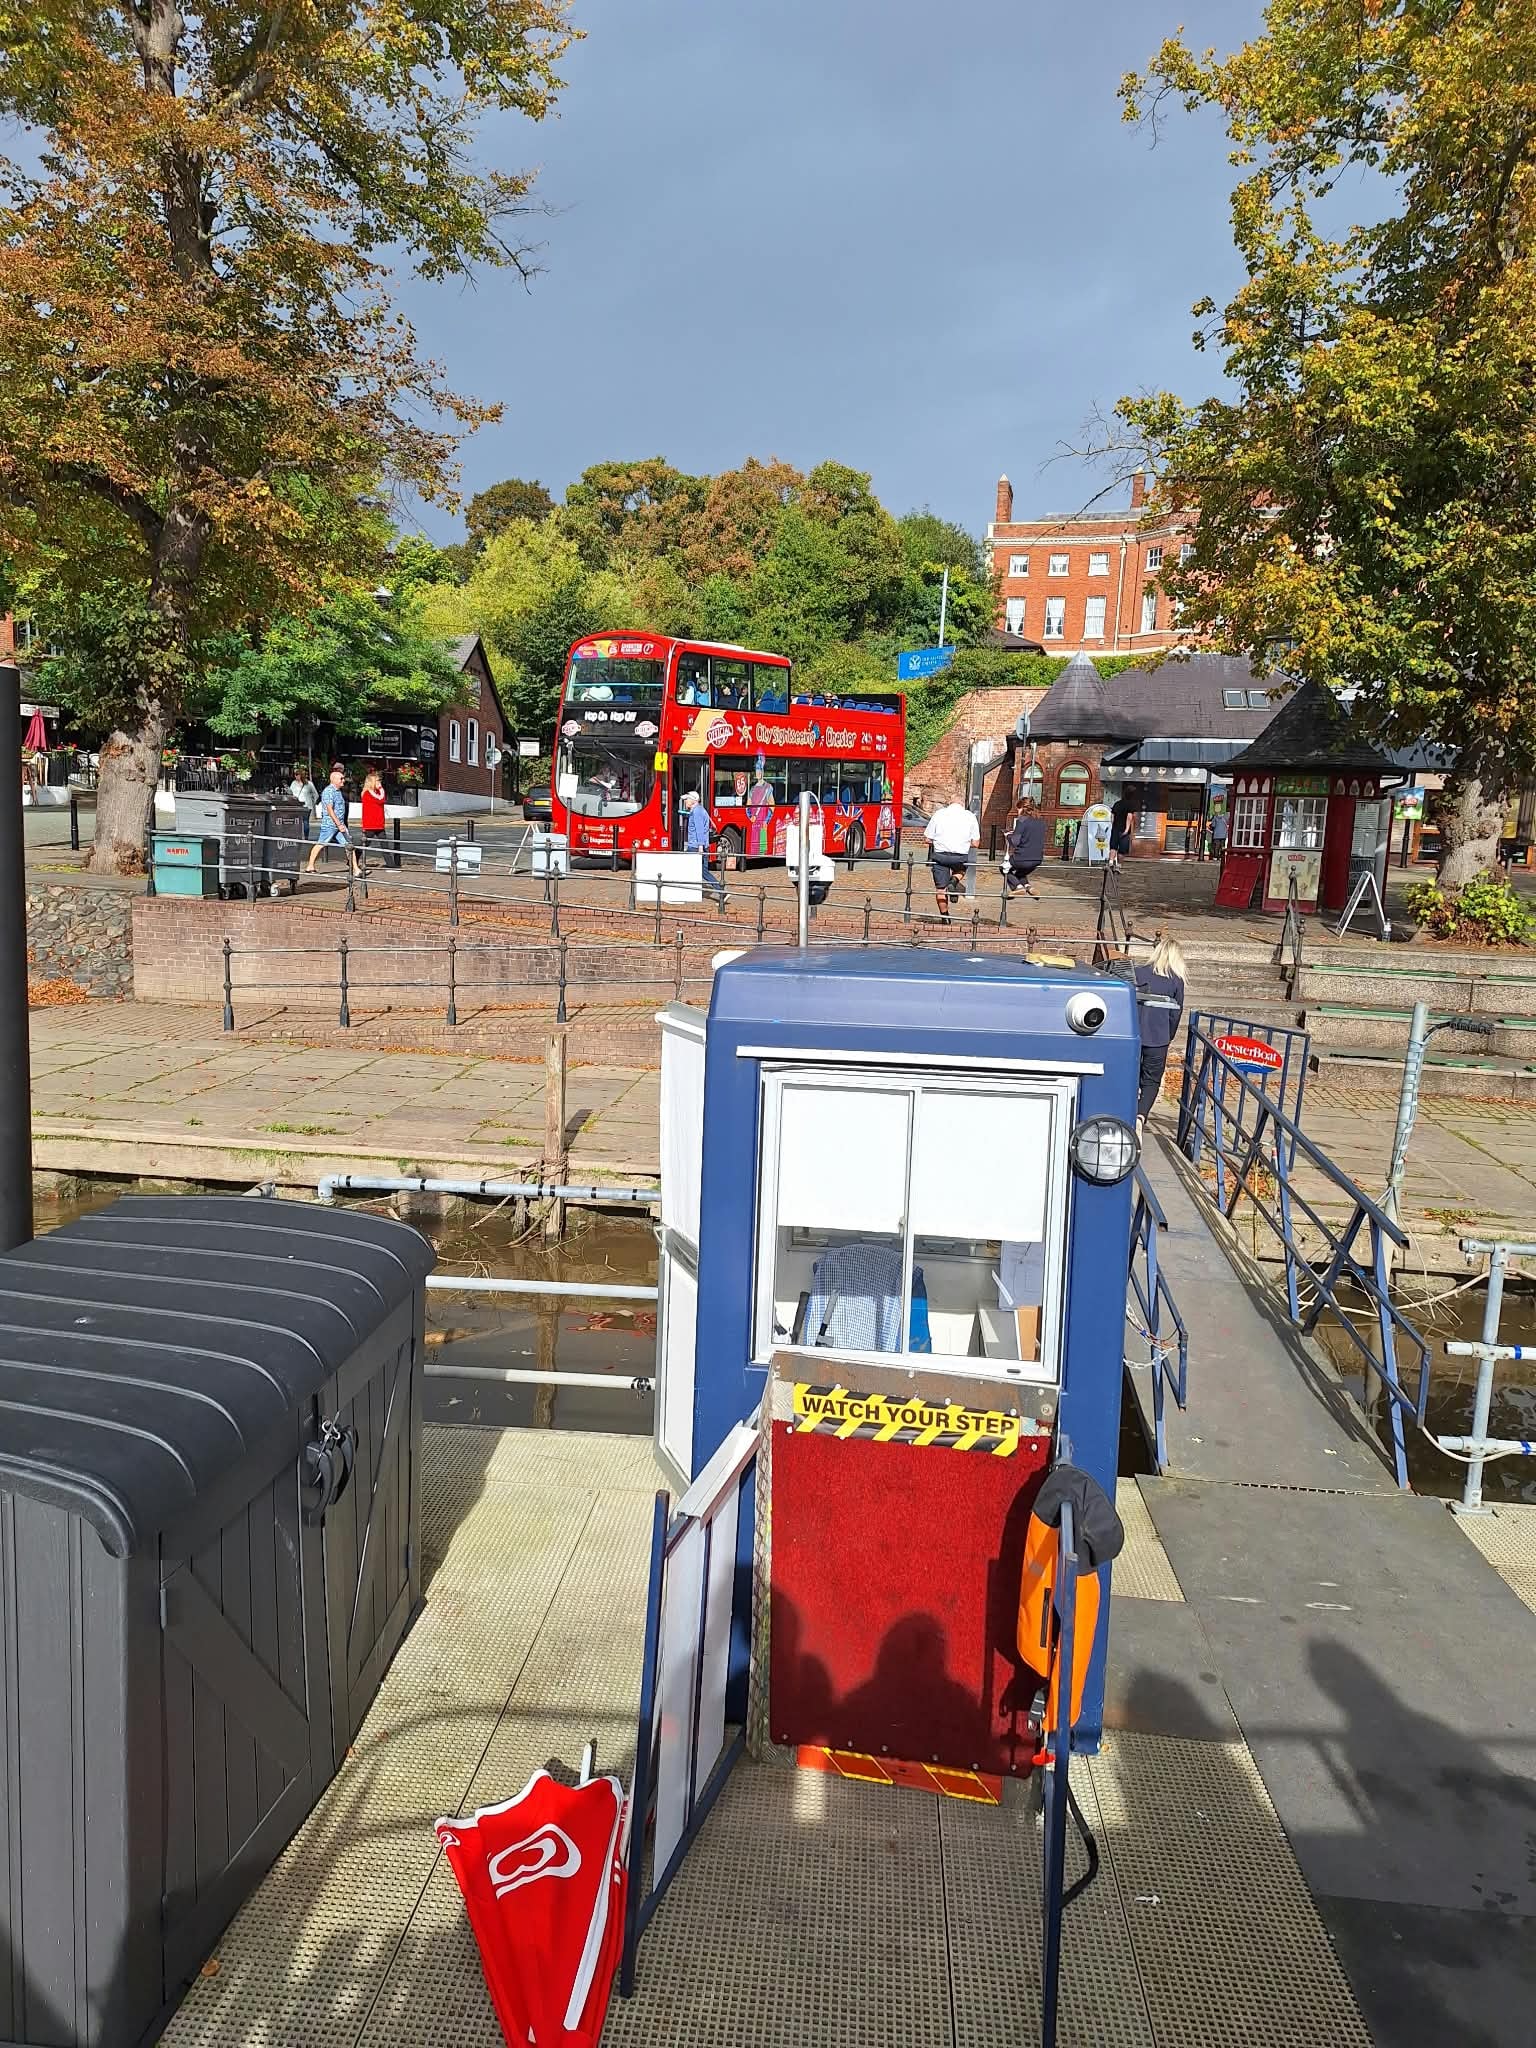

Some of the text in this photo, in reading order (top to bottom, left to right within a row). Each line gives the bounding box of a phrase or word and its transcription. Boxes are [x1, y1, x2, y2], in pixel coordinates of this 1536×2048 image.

[826, 726, 857, 748] Chester
[1215, 1039, 1277, 1061] ChesterBoat
[802, 1396, 1014, 1436] WATCH YOUR STEP
